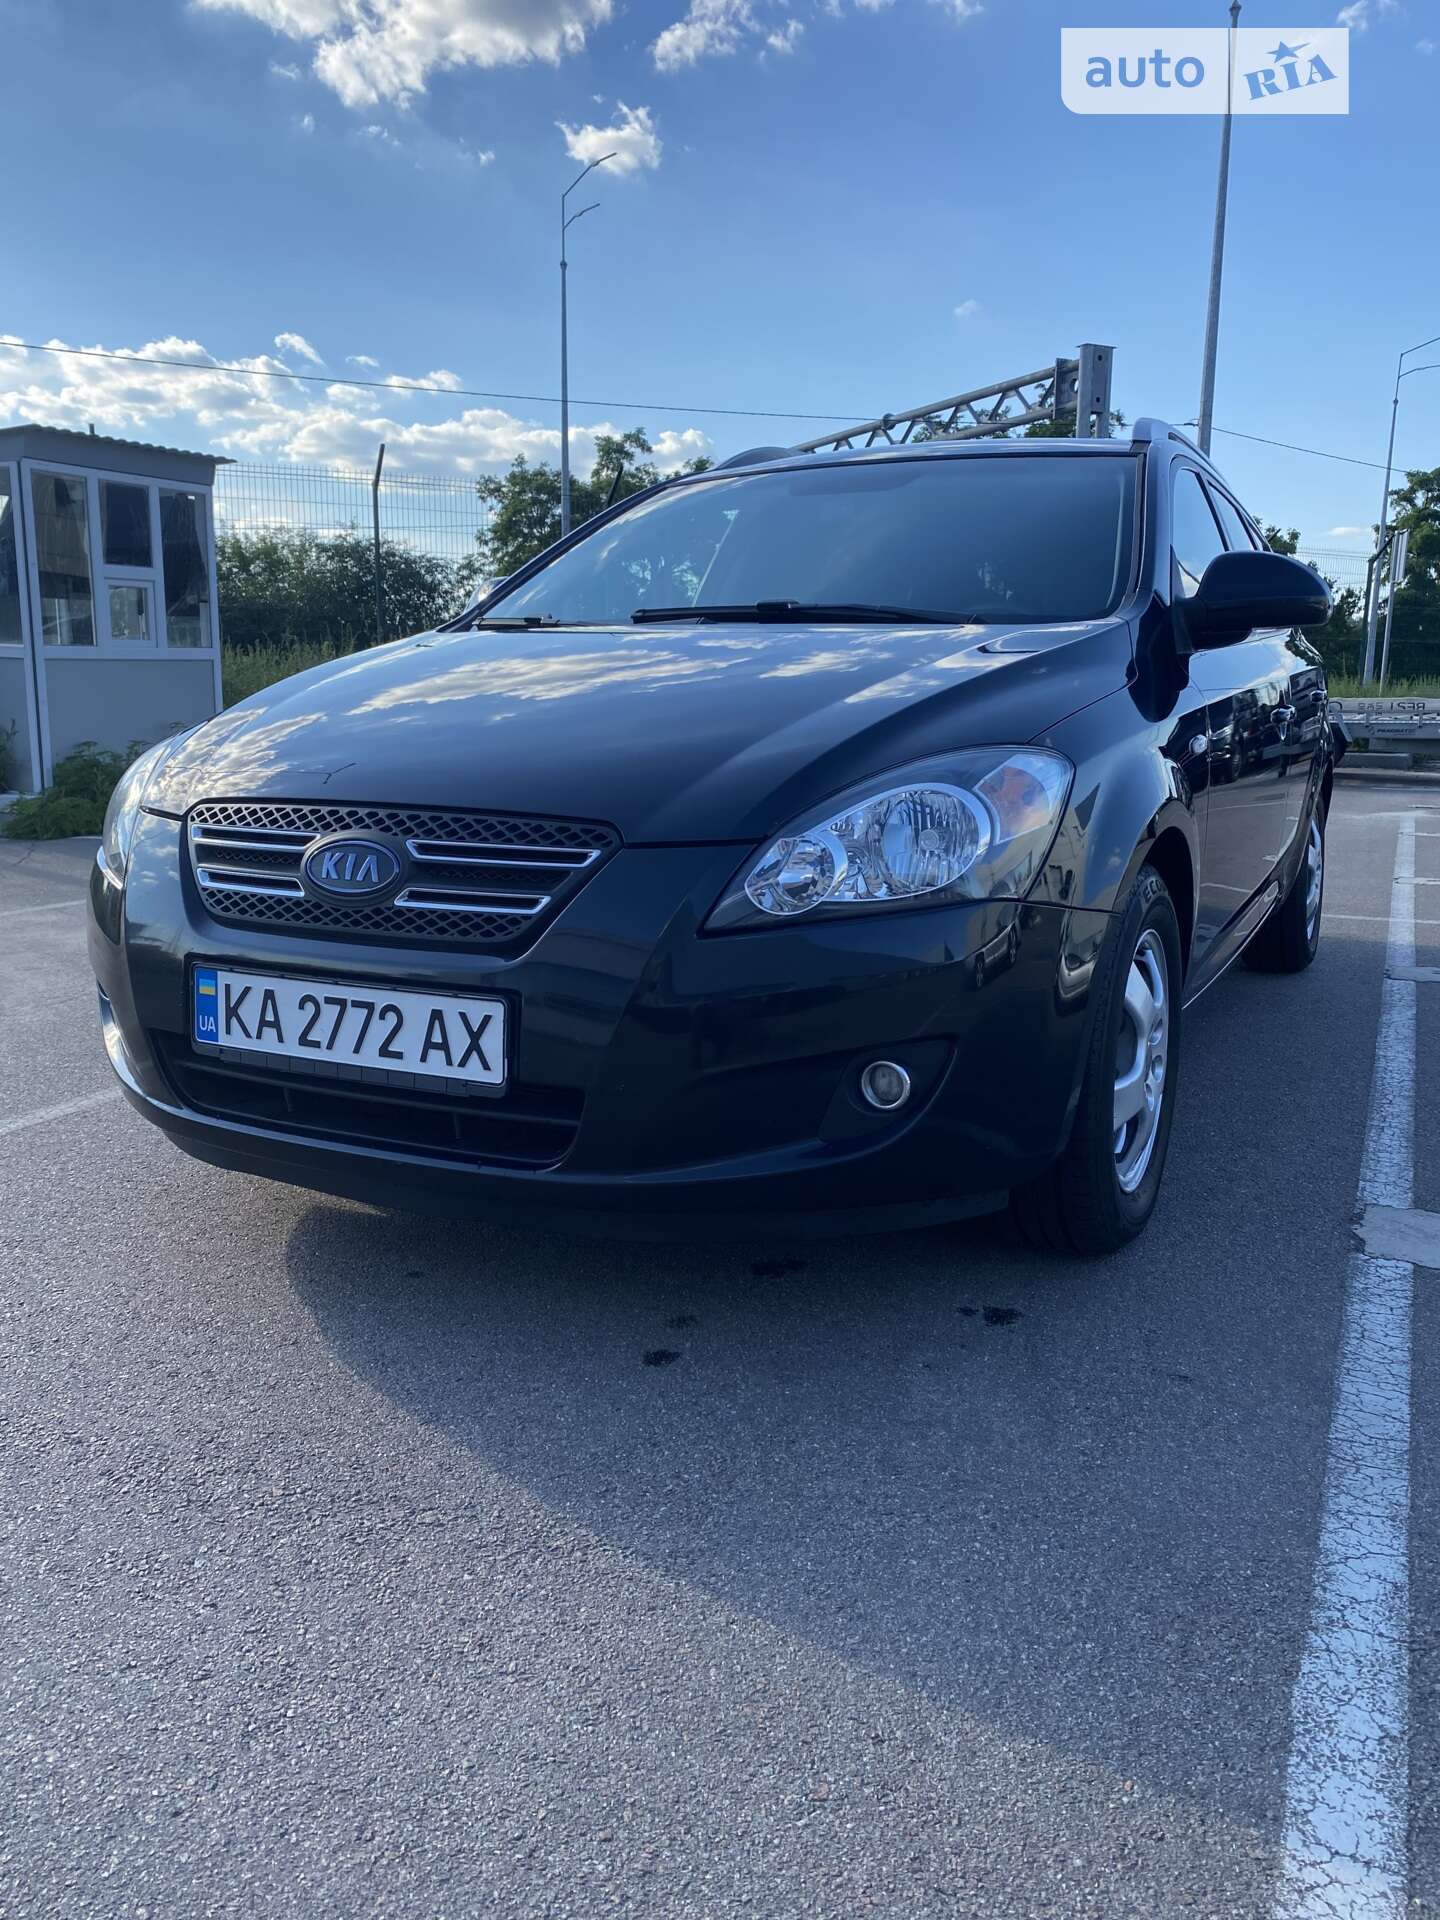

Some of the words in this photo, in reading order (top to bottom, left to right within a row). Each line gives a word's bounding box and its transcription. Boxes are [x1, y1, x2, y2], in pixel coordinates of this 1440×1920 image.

[322, 851, 379, 882] KIA
[199, 1014, 216, 1033] UA
[224, 983, 284, 1043] KA
[298, 994, 404, 1060] 2772
[420, 1009, 492, 1071] AX
